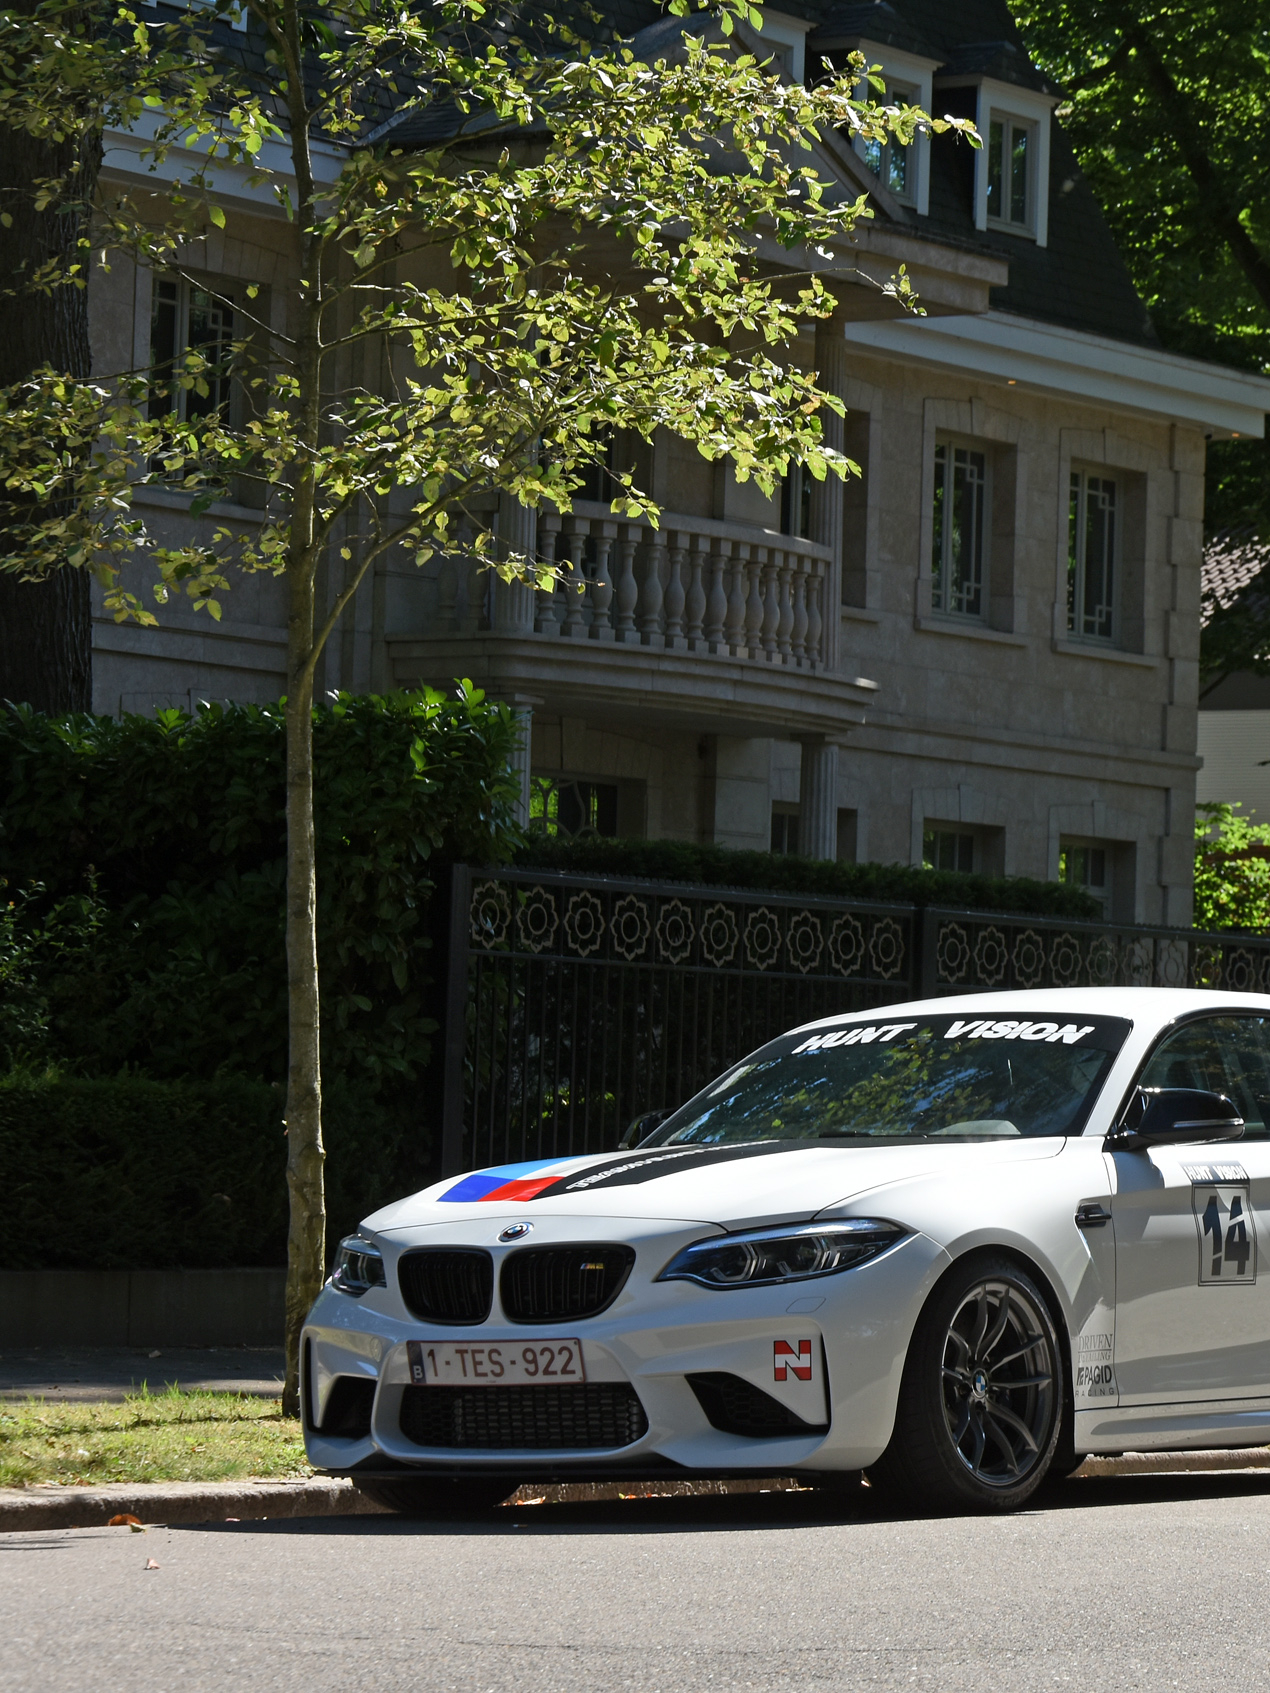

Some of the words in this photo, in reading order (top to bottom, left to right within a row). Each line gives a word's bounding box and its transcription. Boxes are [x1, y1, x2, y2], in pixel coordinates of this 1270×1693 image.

[791, 1022, 918, 1054] HUNT
[944, 1020, 1095, 1044] VISION
[1182, 1165, 1214, 1180] HUNT
[1212, 1165, 1249, 1180] VISION
[1202, 1195, 1250, 1276] 14
[1078, 1333, 1113, 1350] DRIVEN
[427, 1346, 576, 1377] 1-TES-922
[774, 1339, 812, 1381] N
[413, 1365, 423, 1379] B
[1084, 1364, 1113, 1385] PAGID
[1075, 1387, 1115, 1397] RACING
